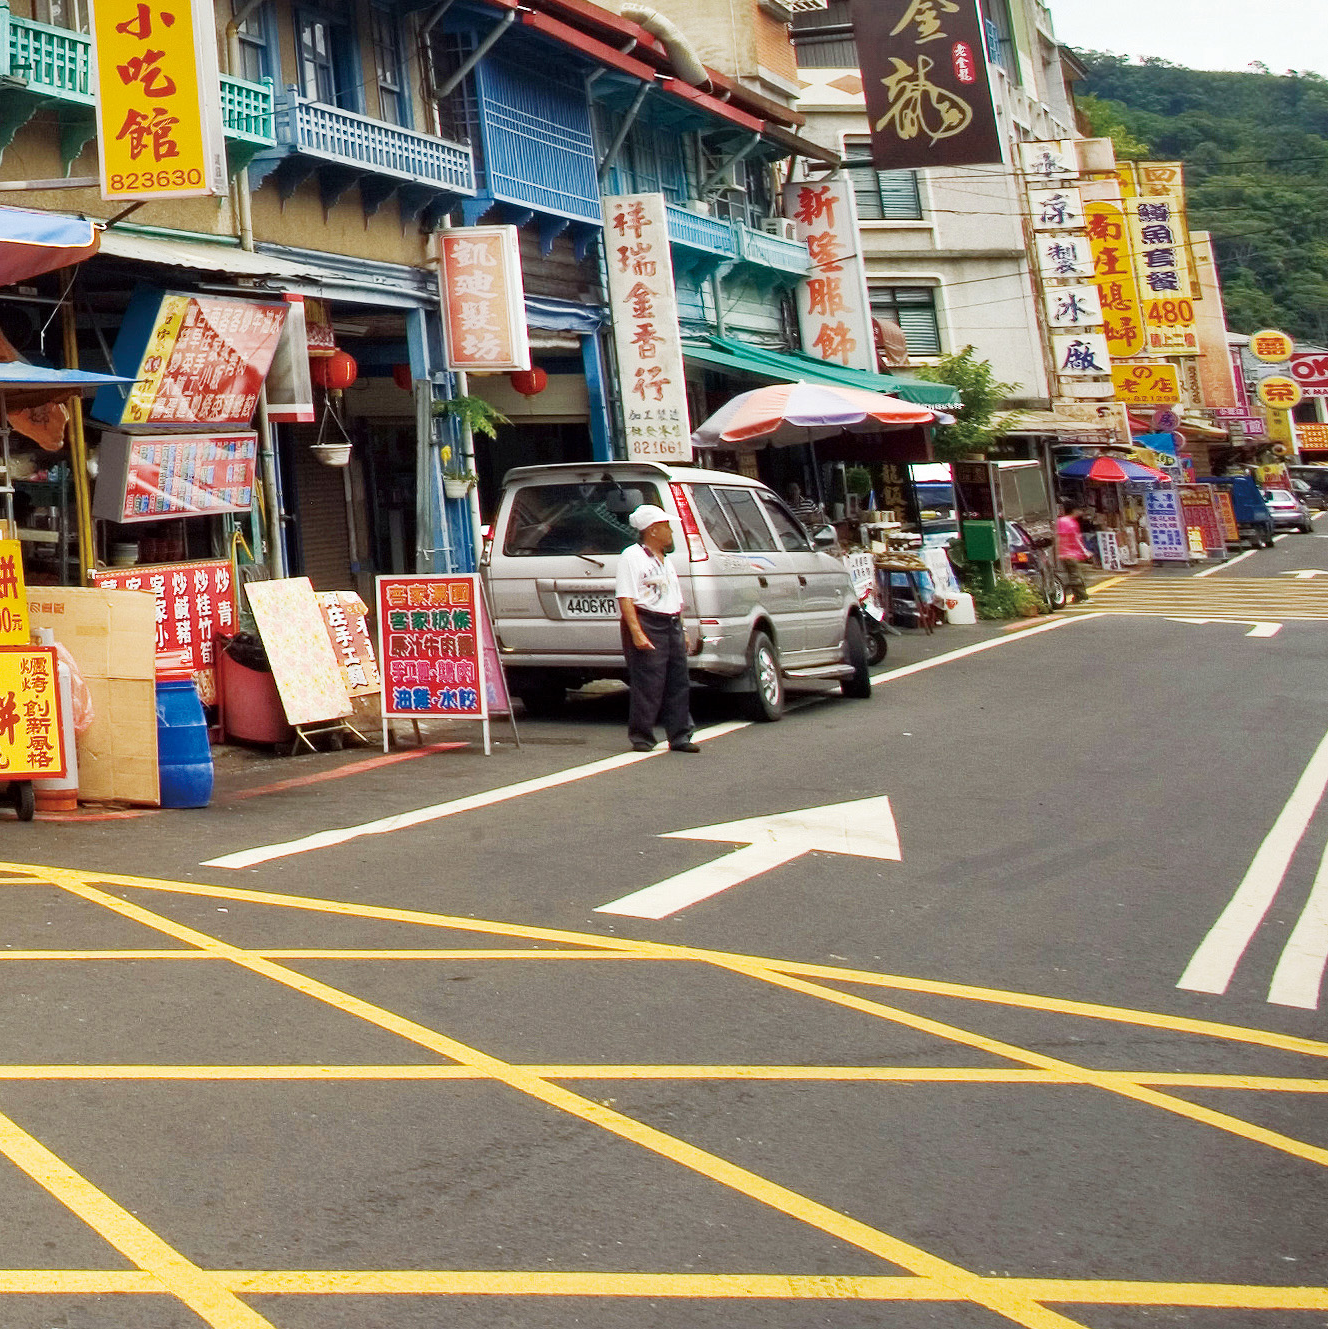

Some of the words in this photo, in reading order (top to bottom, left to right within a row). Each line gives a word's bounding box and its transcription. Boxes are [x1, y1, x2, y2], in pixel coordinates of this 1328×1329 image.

[110, 168, 202, 192] 823630
[613, 200, 671, 402] 祥瑞金香行
[1148, 299, 1193, 323] 480
